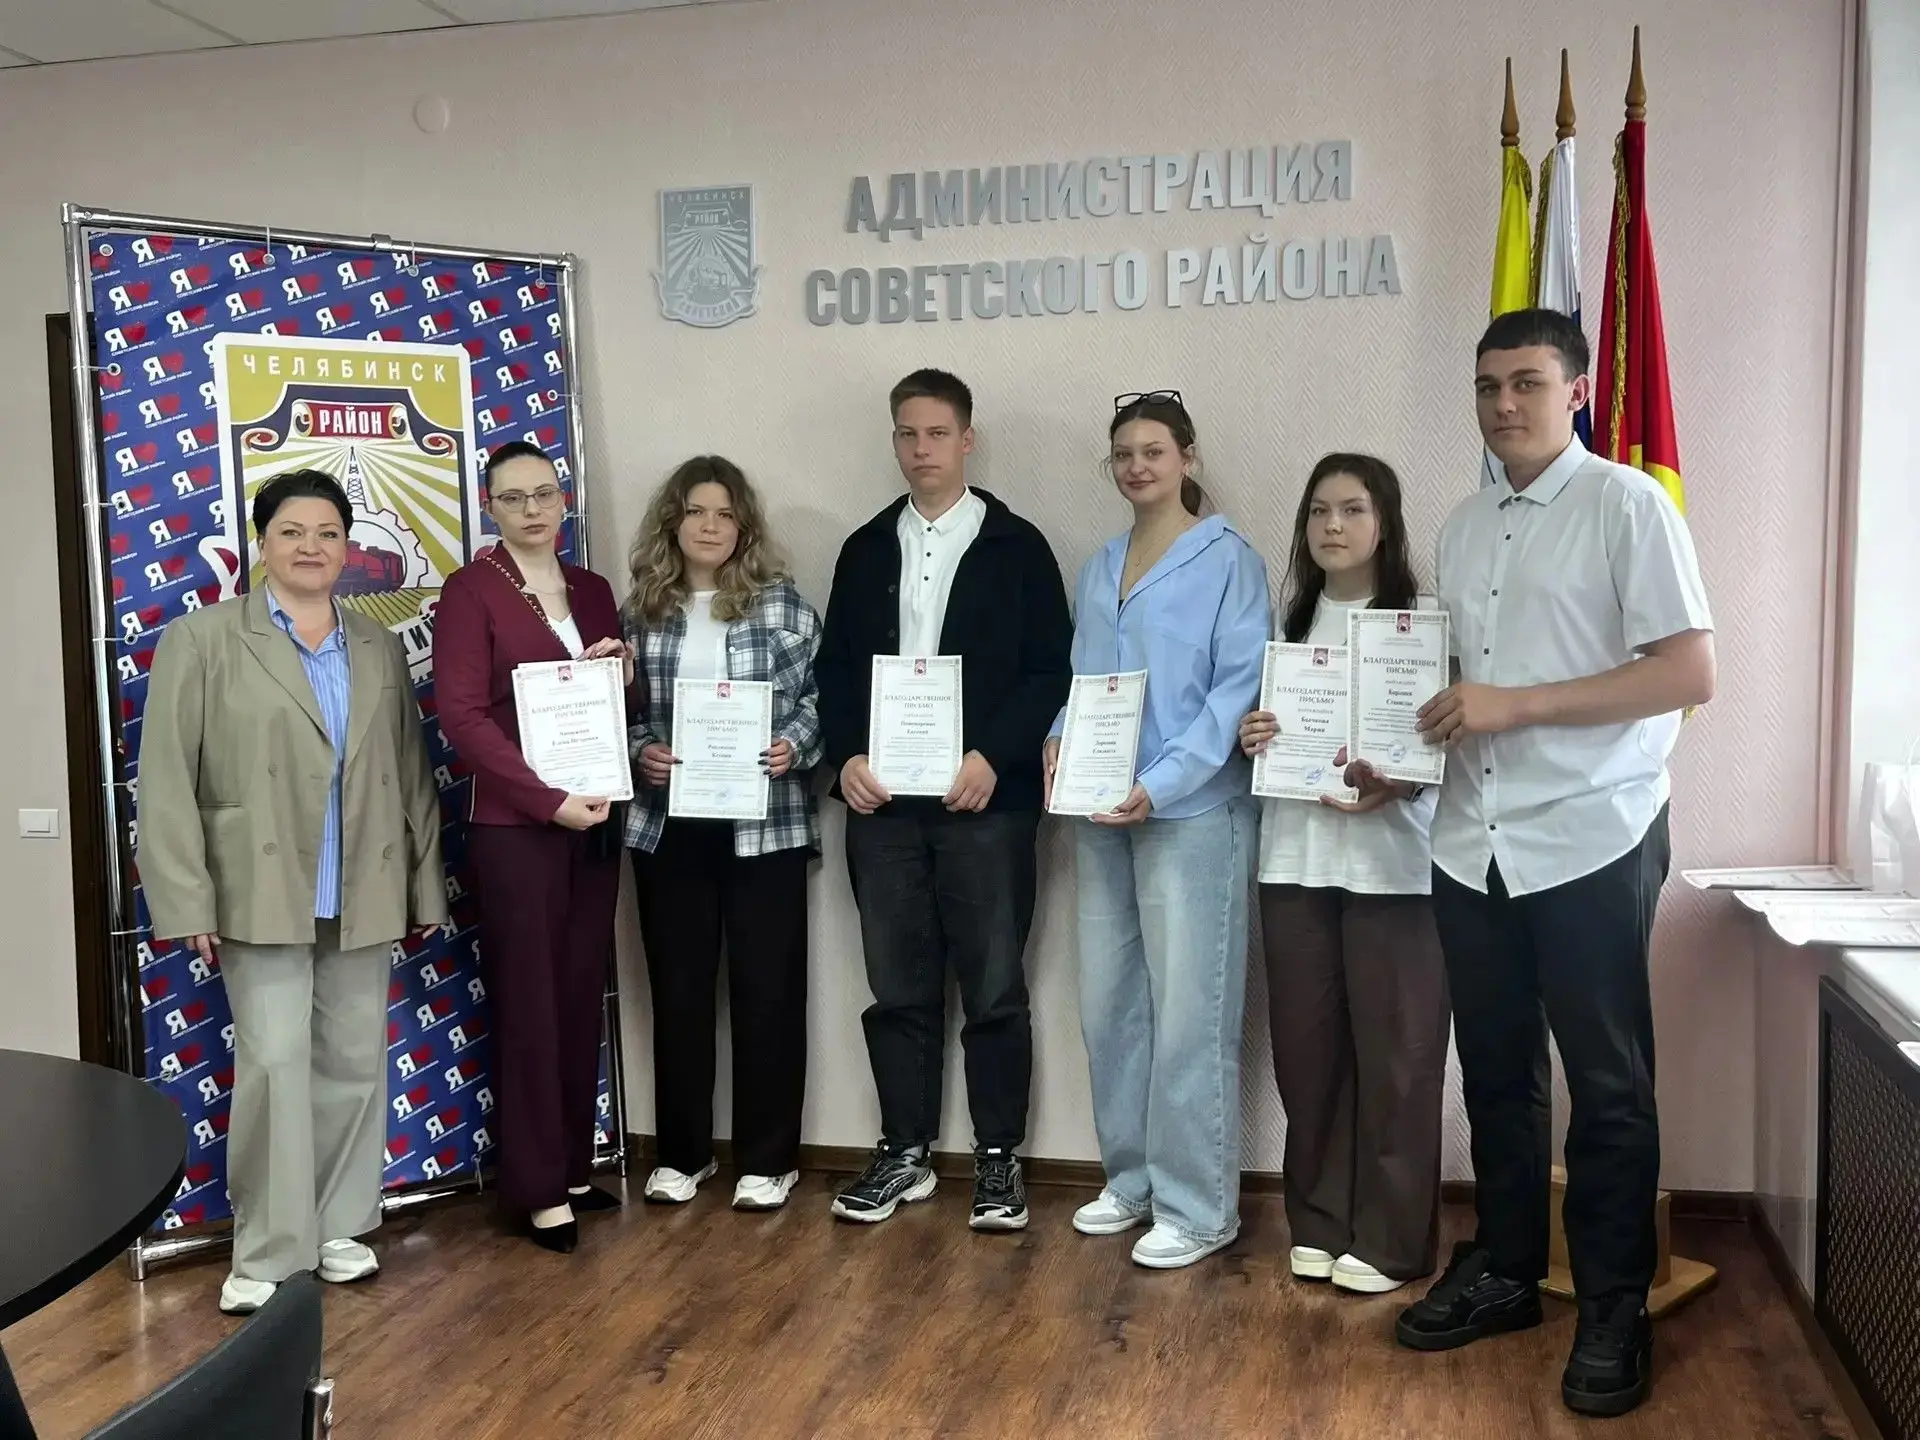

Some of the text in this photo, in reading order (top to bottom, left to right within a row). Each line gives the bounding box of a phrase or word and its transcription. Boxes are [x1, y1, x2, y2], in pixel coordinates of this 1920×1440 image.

[847, 140, 1351, 242] АДМИНИСТРАЦИЯ
[132, 238, 155, 263] Я
[229, 252, 250, 276] Я
[338, 262, 357, 285] Я
[472, 262, 490, 284] Я
[170, 269, 192, 293] Я
[282, 278, 303, 301] Я
[422, 276, 440, 298] Я
[806, 232, 1400, 326] СОВЕТСКОГО РАЙОНА
[109, 286, 132, 310] Я
[226, 293, 247, 317] Я
[370, 292, 390, 314] Я
[517, 286, 534, 308] Я
[166, 311, 188, 333] Я
[316, 307, 336, 330] Я
[469, 300, 487, 323] Я
[419, 315, 437, 337] Я
[105, 328, 128, 352] Я
[499, 328, 517, 350] Я
[143, 357, 166, 381] Я
[243, 354, 445, 382] ЧЕЛЯБИНСК
[544, 350, 562, 372] Я
[496, 366, 514, 388] Я
[139, 399, 161, 424] Я
[527, 393, 544, 415] Я
[319, 405, 382, 434] РАЙОН
[478, 409, 496, 431] Я
[177, 428, 198, 453] Я
[115, 447, 138, 472] Я
[172, 471, 194, 495] Я
[111, 490, 133, 515] Я
[149, 519, 171, 544] Я
[145, 562, 167, 587] Я
[182, 590, 203, 613] Я
[117, 655, 138, 680] Я
[1386, 667, 1417, 675] ПИСЬМО
[1276, 686, 1347, 697] БЛАГОДАРСТВЕНН
[189, 957, 210, 982] Я
[420, 964, 439, 987] Я
[468, 977, 485, 1001] Я
[165, 1009, 188, 1035] Я
[417, 1004, 436, 1028] Я
[448, 1026, 467, 1050] Я
[396, 1053, 416, 1078] Я
[198, 1076, 220, 1102] Я
[445, 1066, 464, 1090] Я
[393, 1093, 412, 1119] Я
[476, 1087, 493, 1110] Я
[194, 1119, 215, 1145] Я
[425, 1115, 444, 1140] Я
[473, 1127, 491, 1151] Я
[422, 1156, 441, 1180] Я
